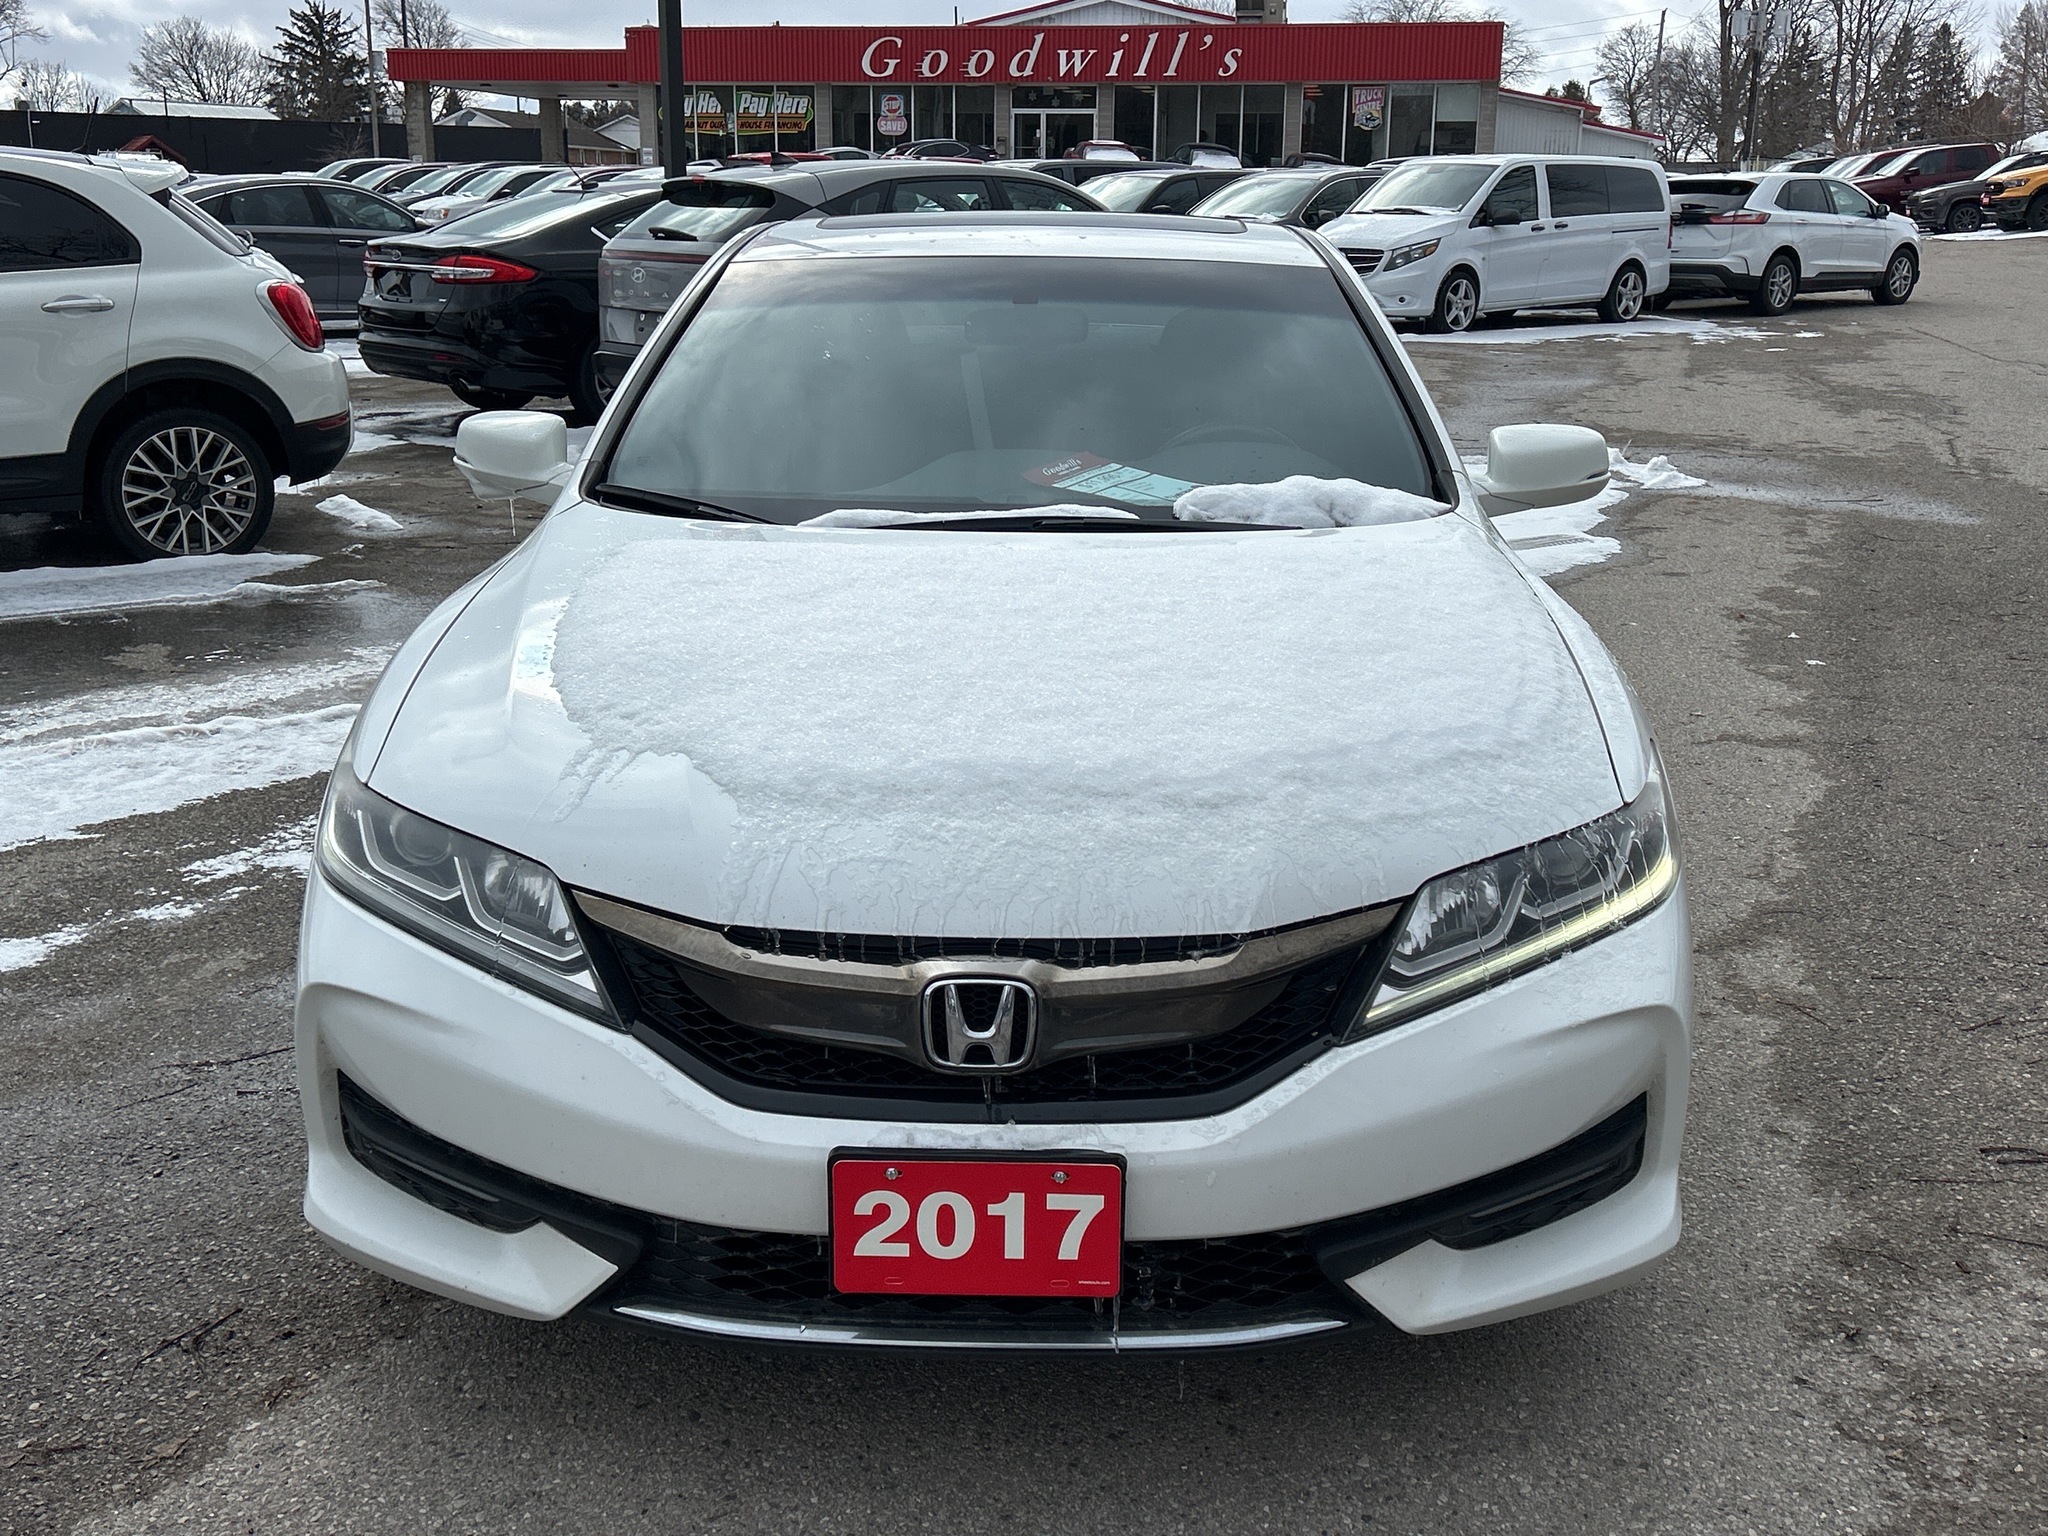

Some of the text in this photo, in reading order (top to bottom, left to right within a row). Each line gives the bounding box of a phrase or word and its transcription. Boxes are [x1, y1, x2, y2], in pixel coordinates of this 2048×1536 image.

[861, 31, 1243, 78] Goodwill's
[739, 93, 808, 117] Pay Here
[885, 101, 900, 110] STOP
[1355, 89, 1383, 104] TRUCK
[880, 120, 904, 132] SAVE!
[853, 1190, 1105, 1260] 2017
